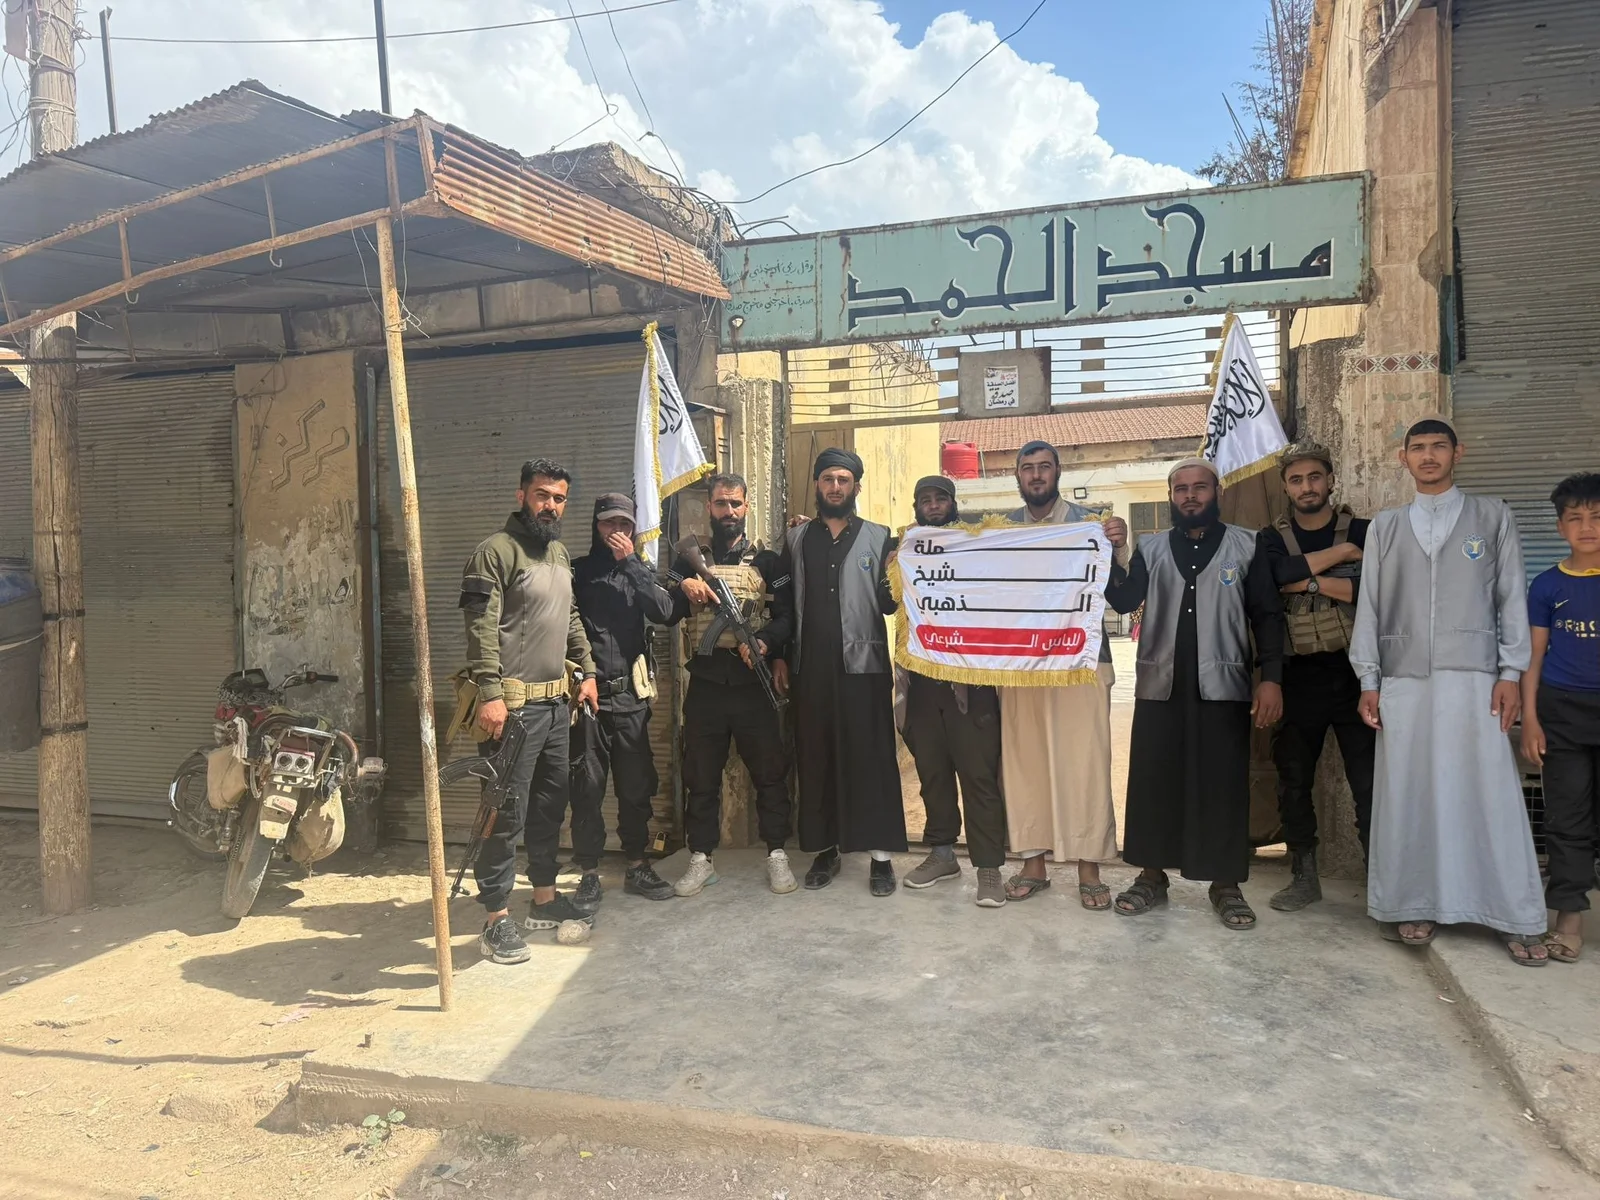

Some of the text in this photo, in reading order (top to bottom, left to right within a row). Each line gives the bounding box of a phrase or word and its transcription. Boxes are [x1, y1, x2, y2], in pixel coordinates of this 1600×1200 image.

[848, 203, 1334, 335] مسجد الحمد
[912, 561, 1097, 586] الشيخ
[1042, 632, 1082, 652] للباس
